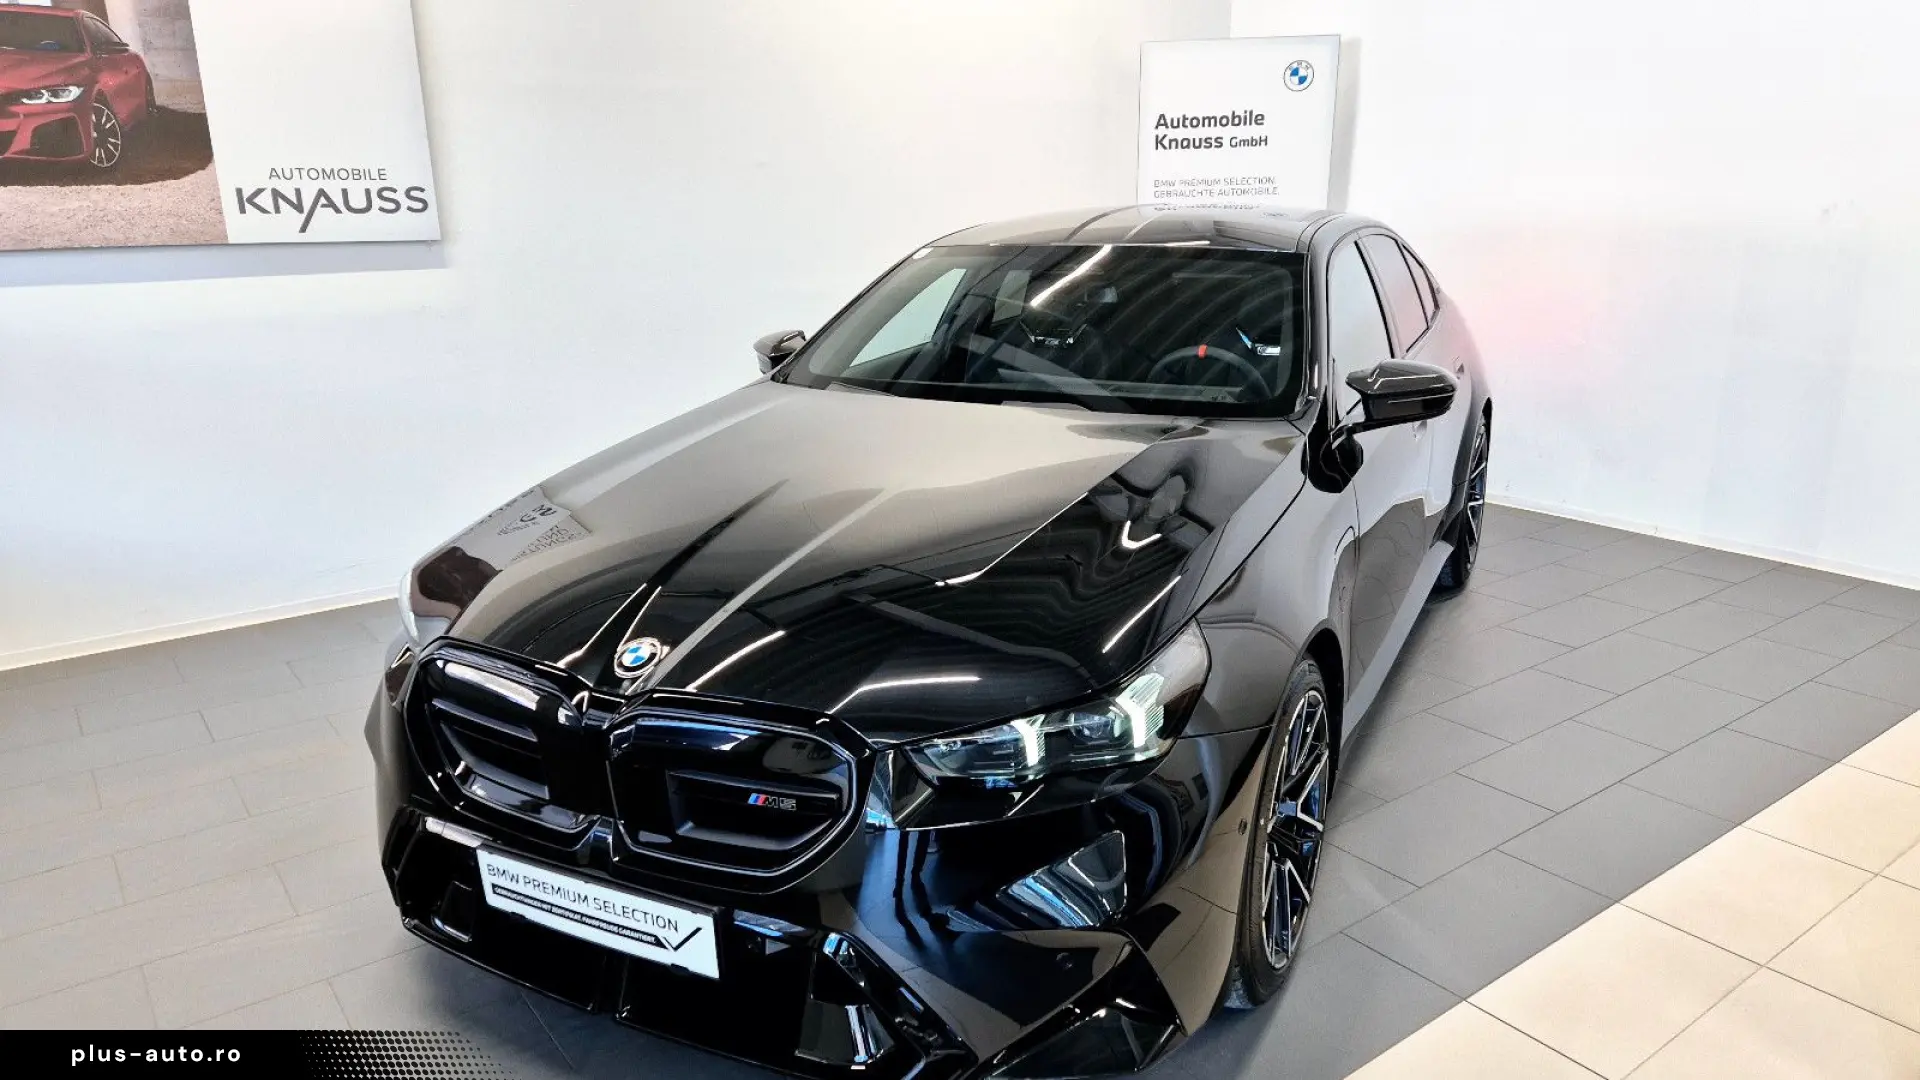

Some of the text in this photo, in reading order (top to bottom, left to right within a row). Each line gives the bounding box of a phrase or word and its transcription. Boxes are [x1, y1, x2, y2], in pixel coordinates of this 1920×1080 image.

[1154, 110, 1265, 130] Automobile
[1154, 133, 1268, 151] Knauss GmbH
[268, 167, 388, 181] AUTOMOBILE
[1179, 178, 1221, 187] PREMIUM
[1223, 176, 1276, 186] SELECTION
[1153, 188, 1215, 199] GEBRAUCHTE
[235, 185, 429, 233] KNAUSS
[486, 863, 520, 886] BMW
[522, 875, 590, 908] PREMIUM
[593, 896, 680, 933] SELECTION
